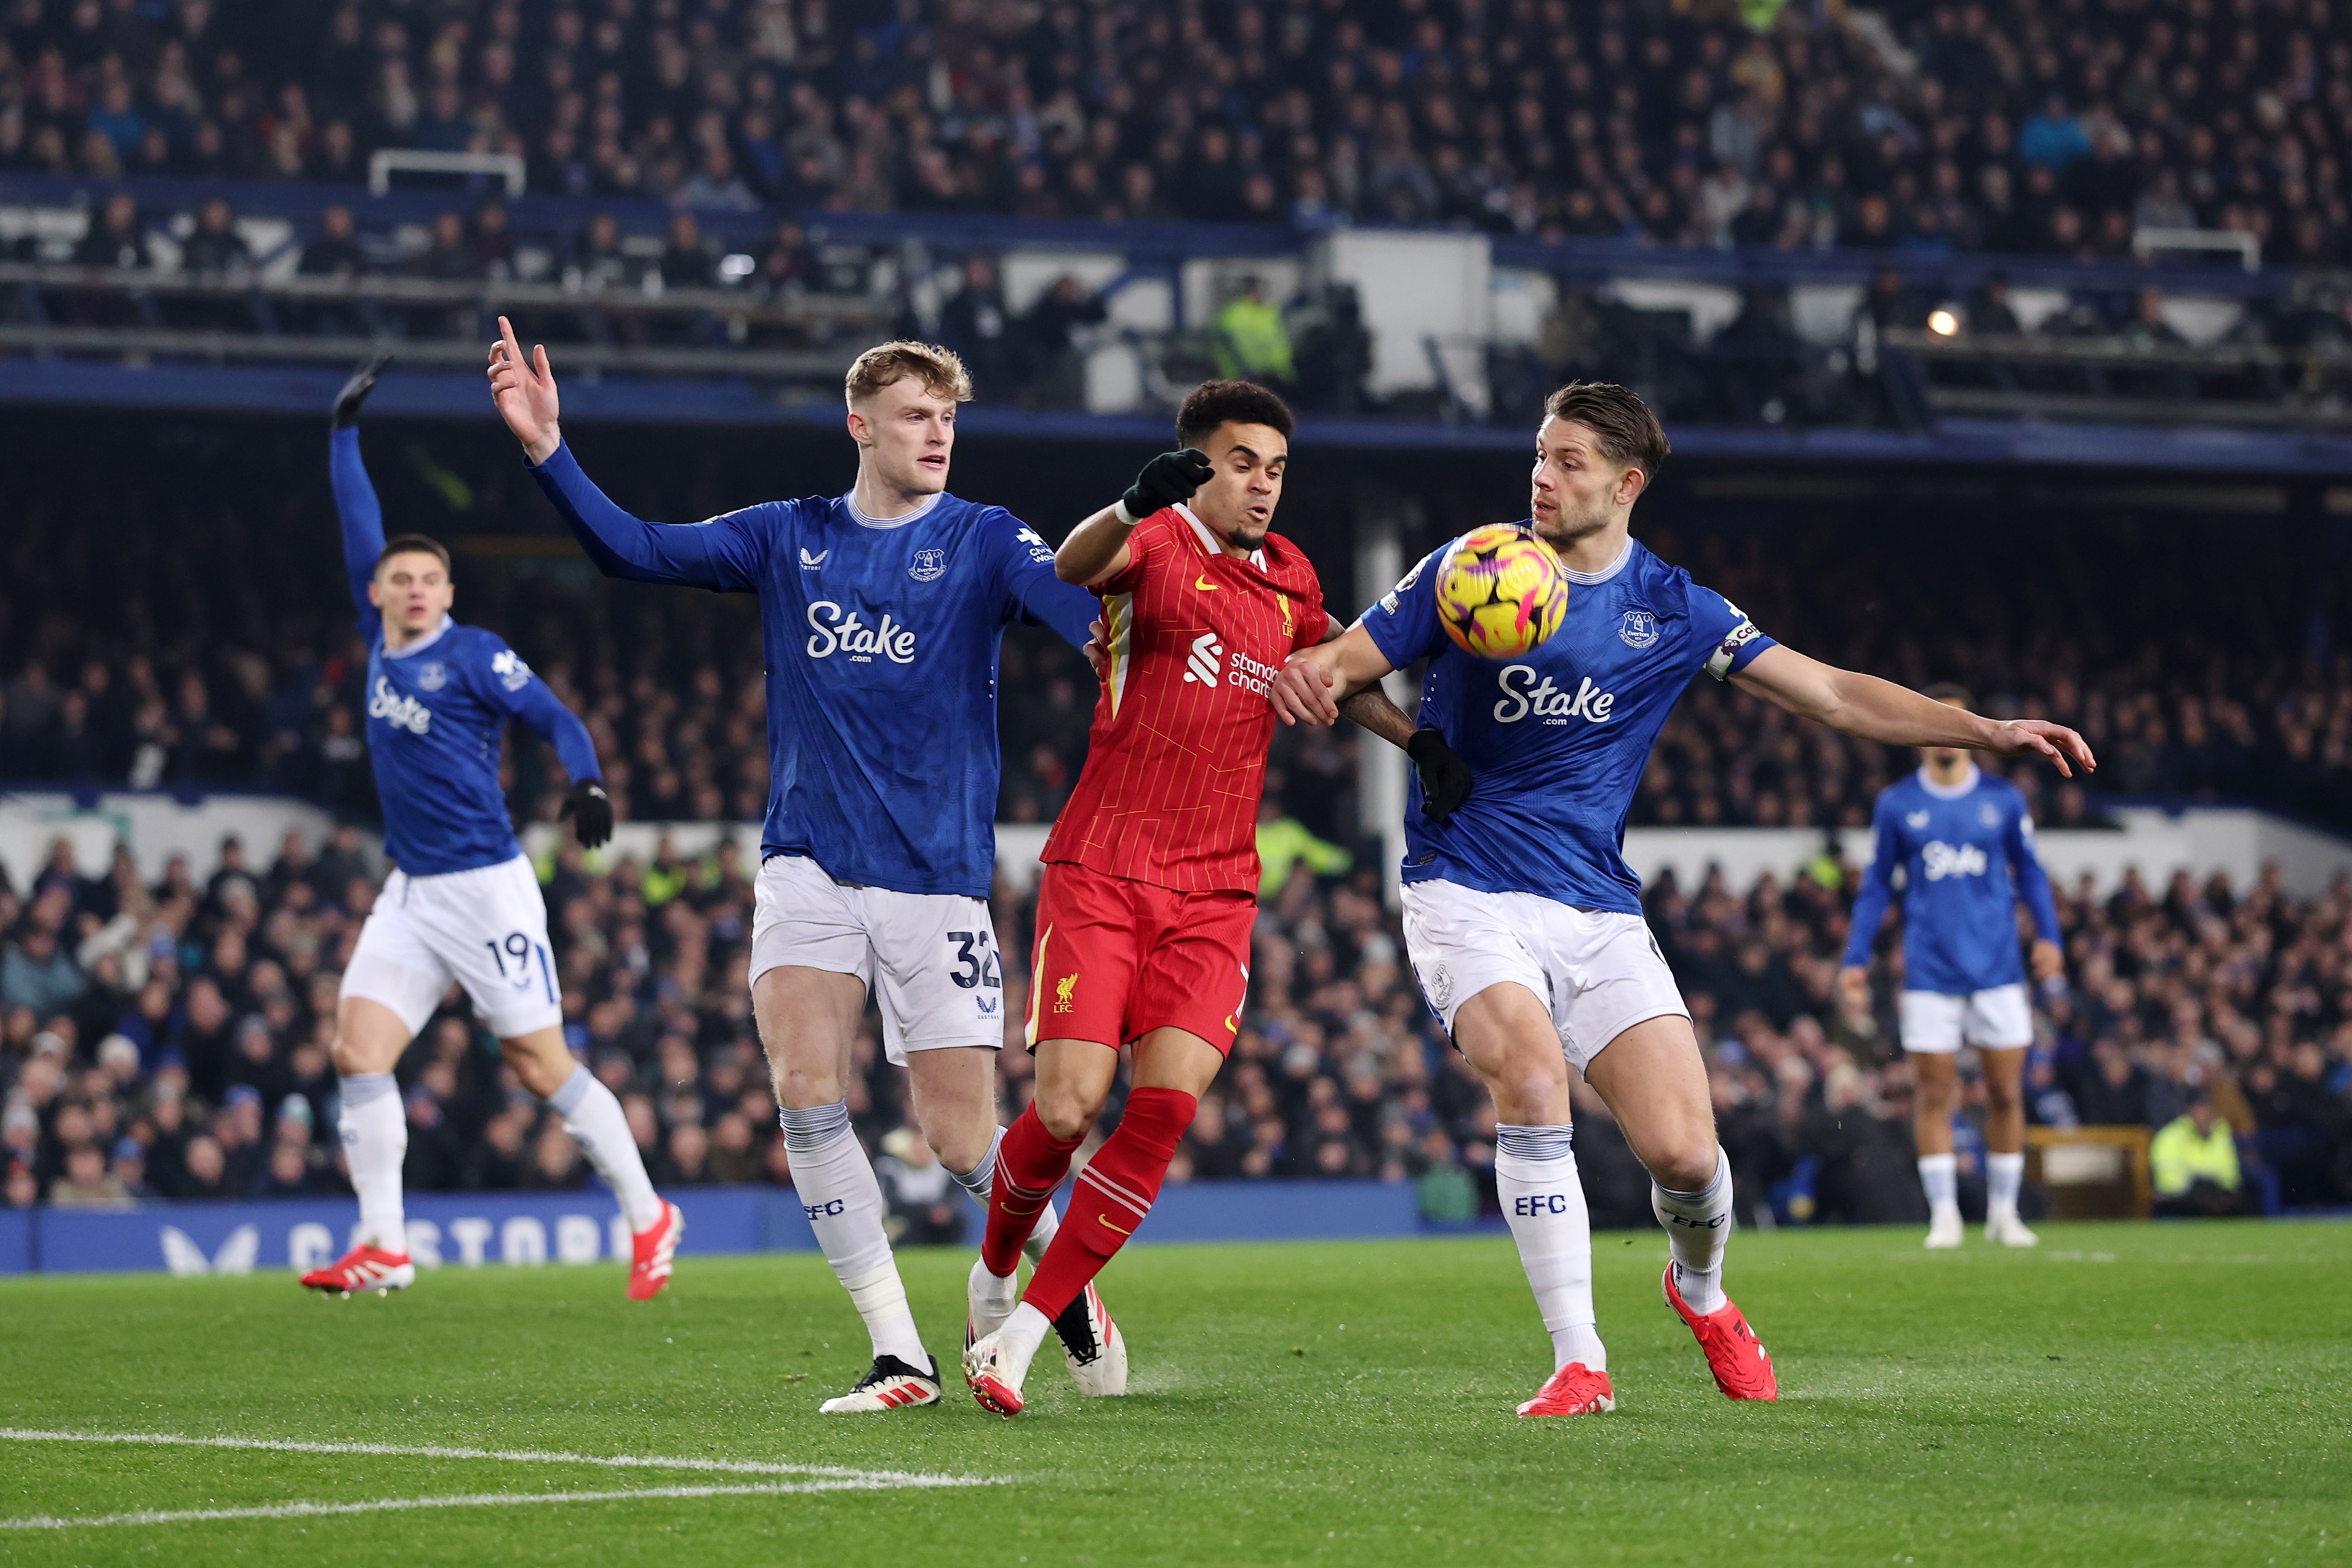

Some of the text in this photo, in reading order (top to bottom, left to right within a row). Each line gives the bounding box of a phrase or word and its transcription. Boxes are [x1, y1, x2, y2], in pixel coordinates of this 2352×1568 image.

[807, 600, 916, 664] Stake
[1627, 629, 1650, 638] Everton
[849, 655, 872, 663] .com
[1228, 669, 1271, 699] chart
[1493, 665, 1614, 723] Stake
[1542, 718, 1568, 726] .com
[486, 933, 528, 977] 19
[947, 930, 1001, 989] 32
[1515, 1194, 1566, 1217] EFC
[1672, 1213, 1725, 1229] EFC
